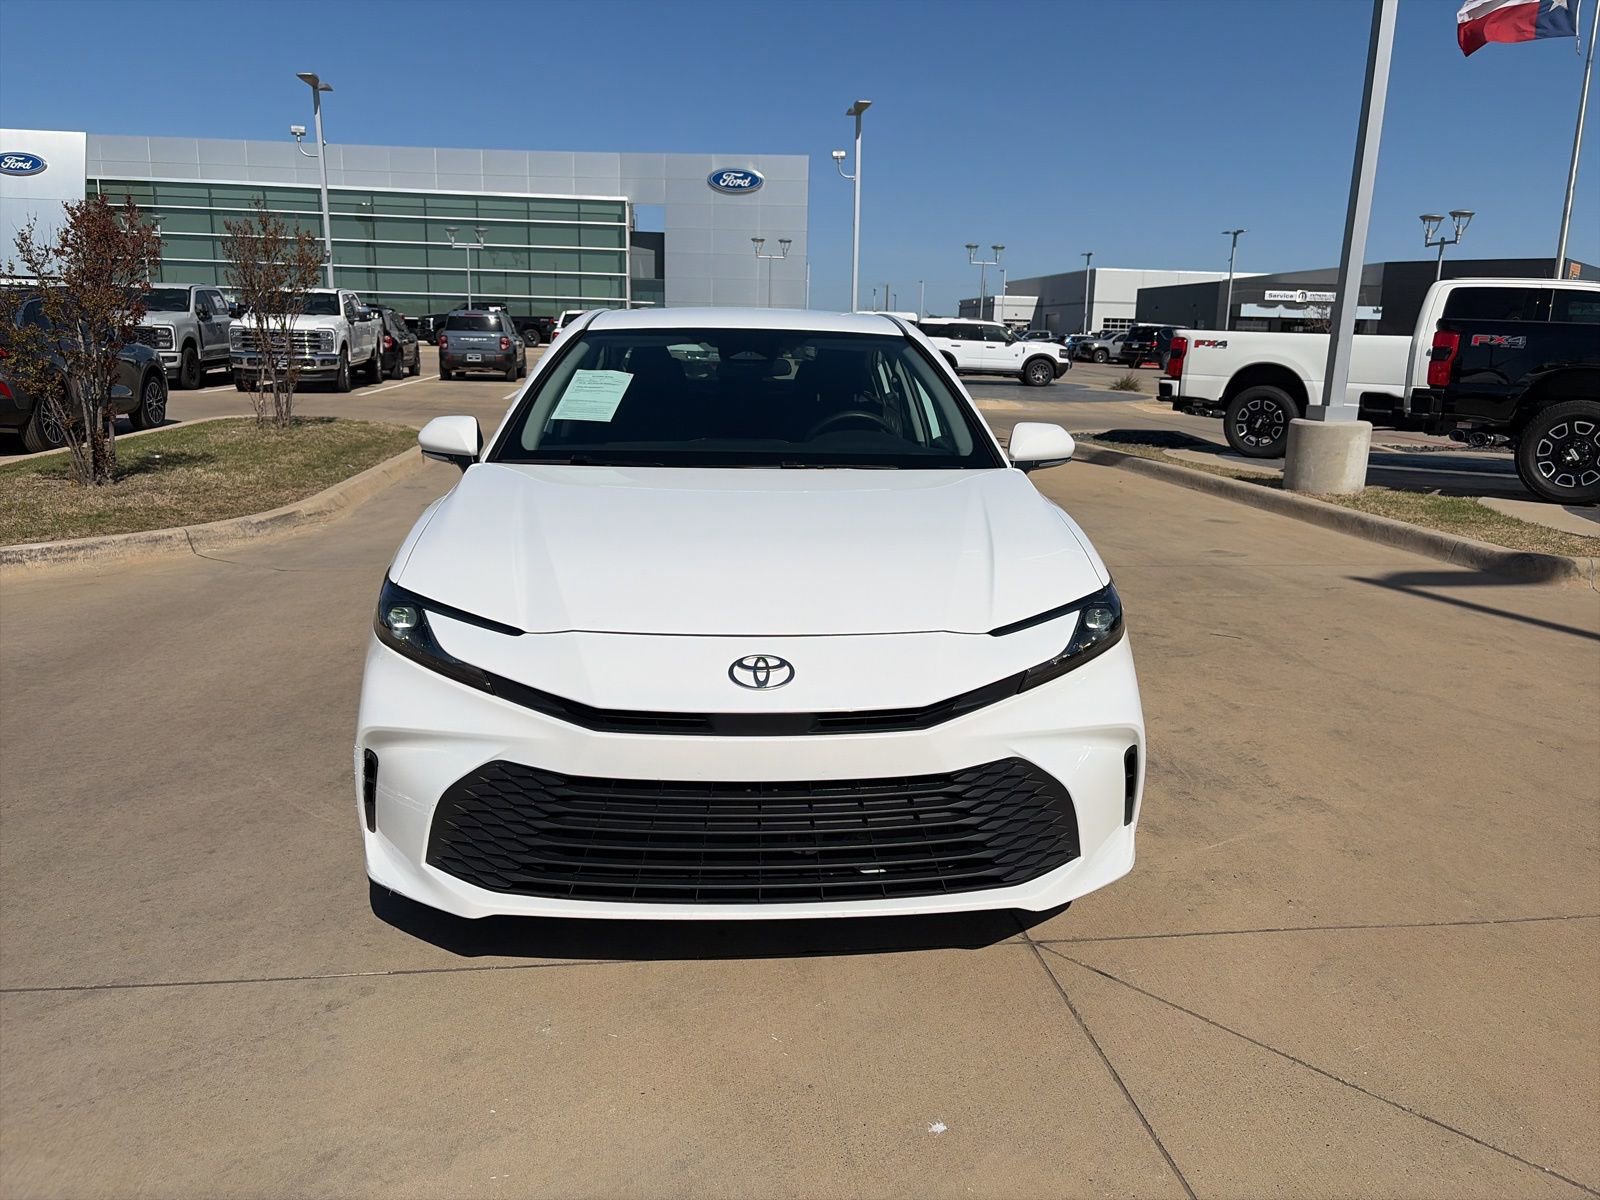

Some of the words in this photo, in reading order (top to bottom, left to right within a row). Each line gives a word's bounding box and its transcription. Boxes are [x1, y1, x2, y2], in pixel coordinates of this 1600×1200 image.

[1, 156, 32, 169] Ford
[720, 172, 751, 186] Ford
[1193, 339, 1228, 349] FX4
[1470, 334, 1527, 349] FX4
